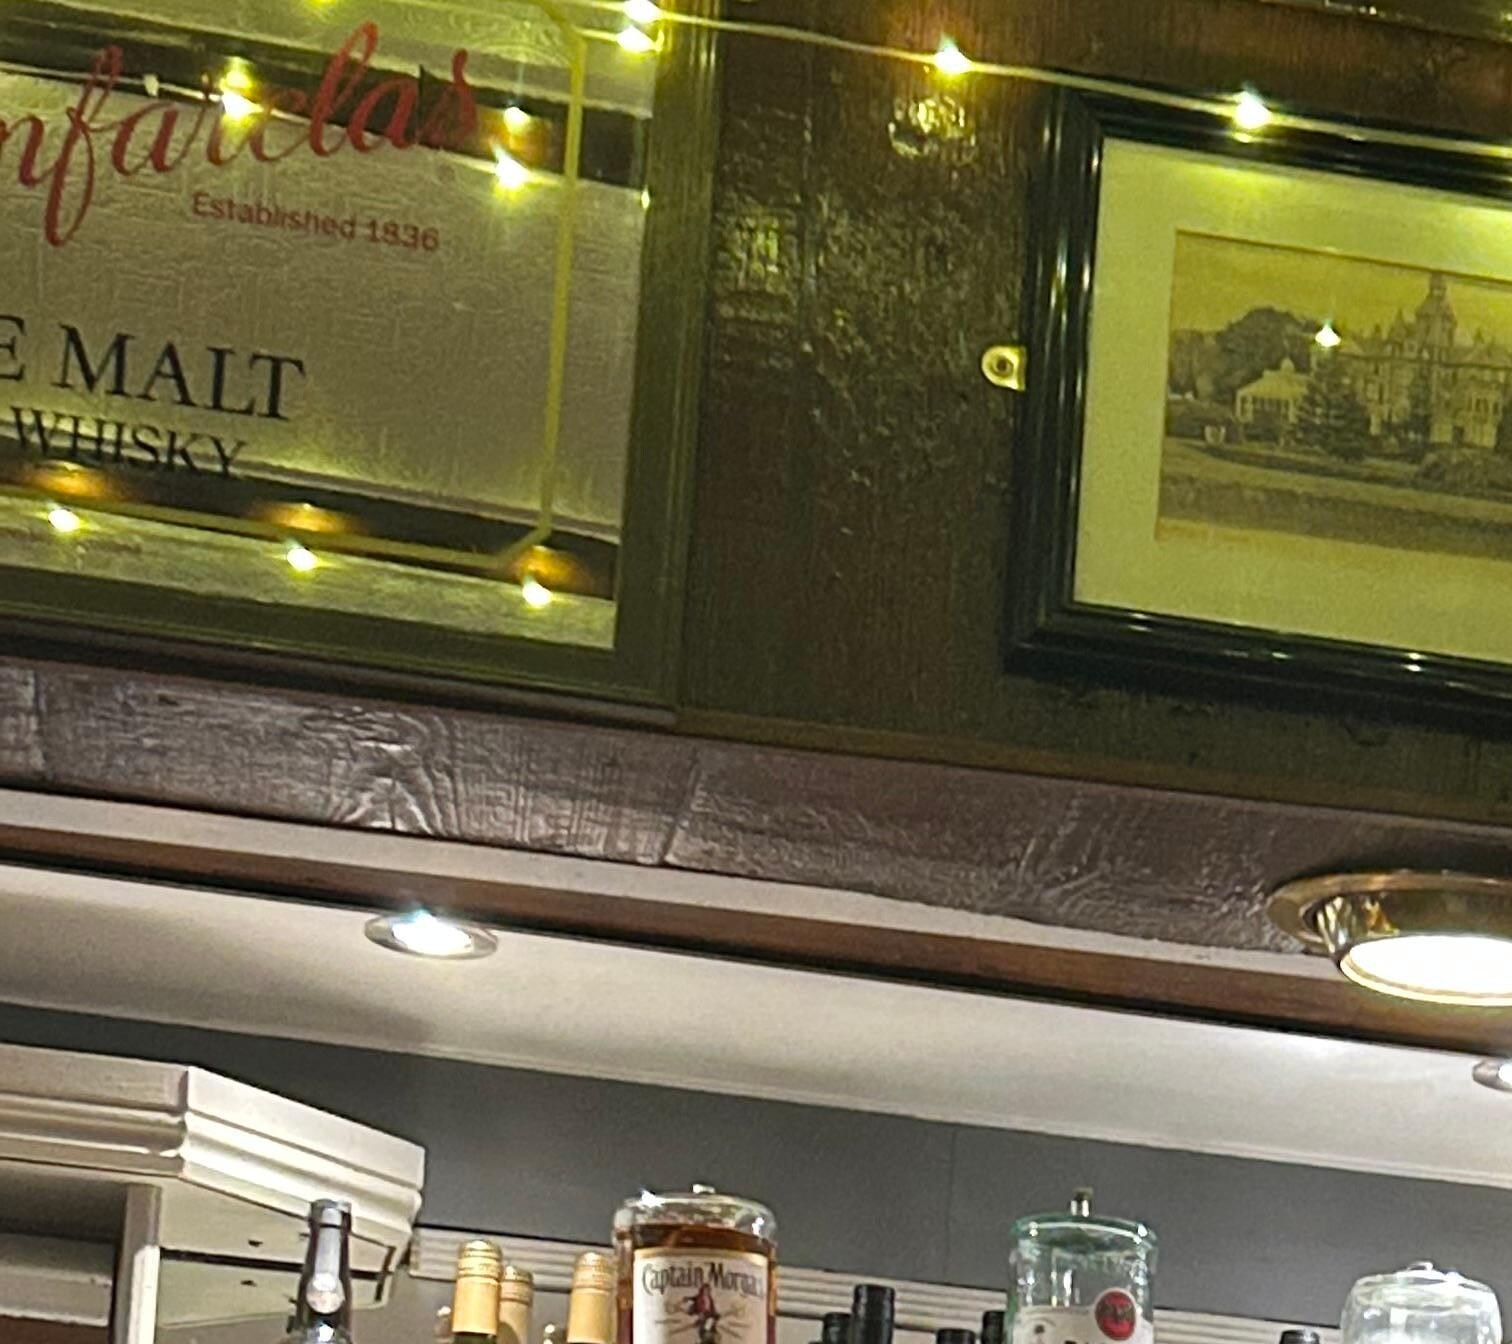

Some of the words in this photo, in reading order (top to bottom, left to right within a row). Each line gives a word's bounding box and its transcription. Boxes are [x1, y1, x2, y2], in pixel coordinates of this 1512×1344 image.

[192, 191, 356, 240] Established
[365, 219, 440, 252] 1836
[52, 322, 306, 422] MALT
[10, 406, 248, 478] WHISKY
[642, 1261, 704, 1297] Captain
